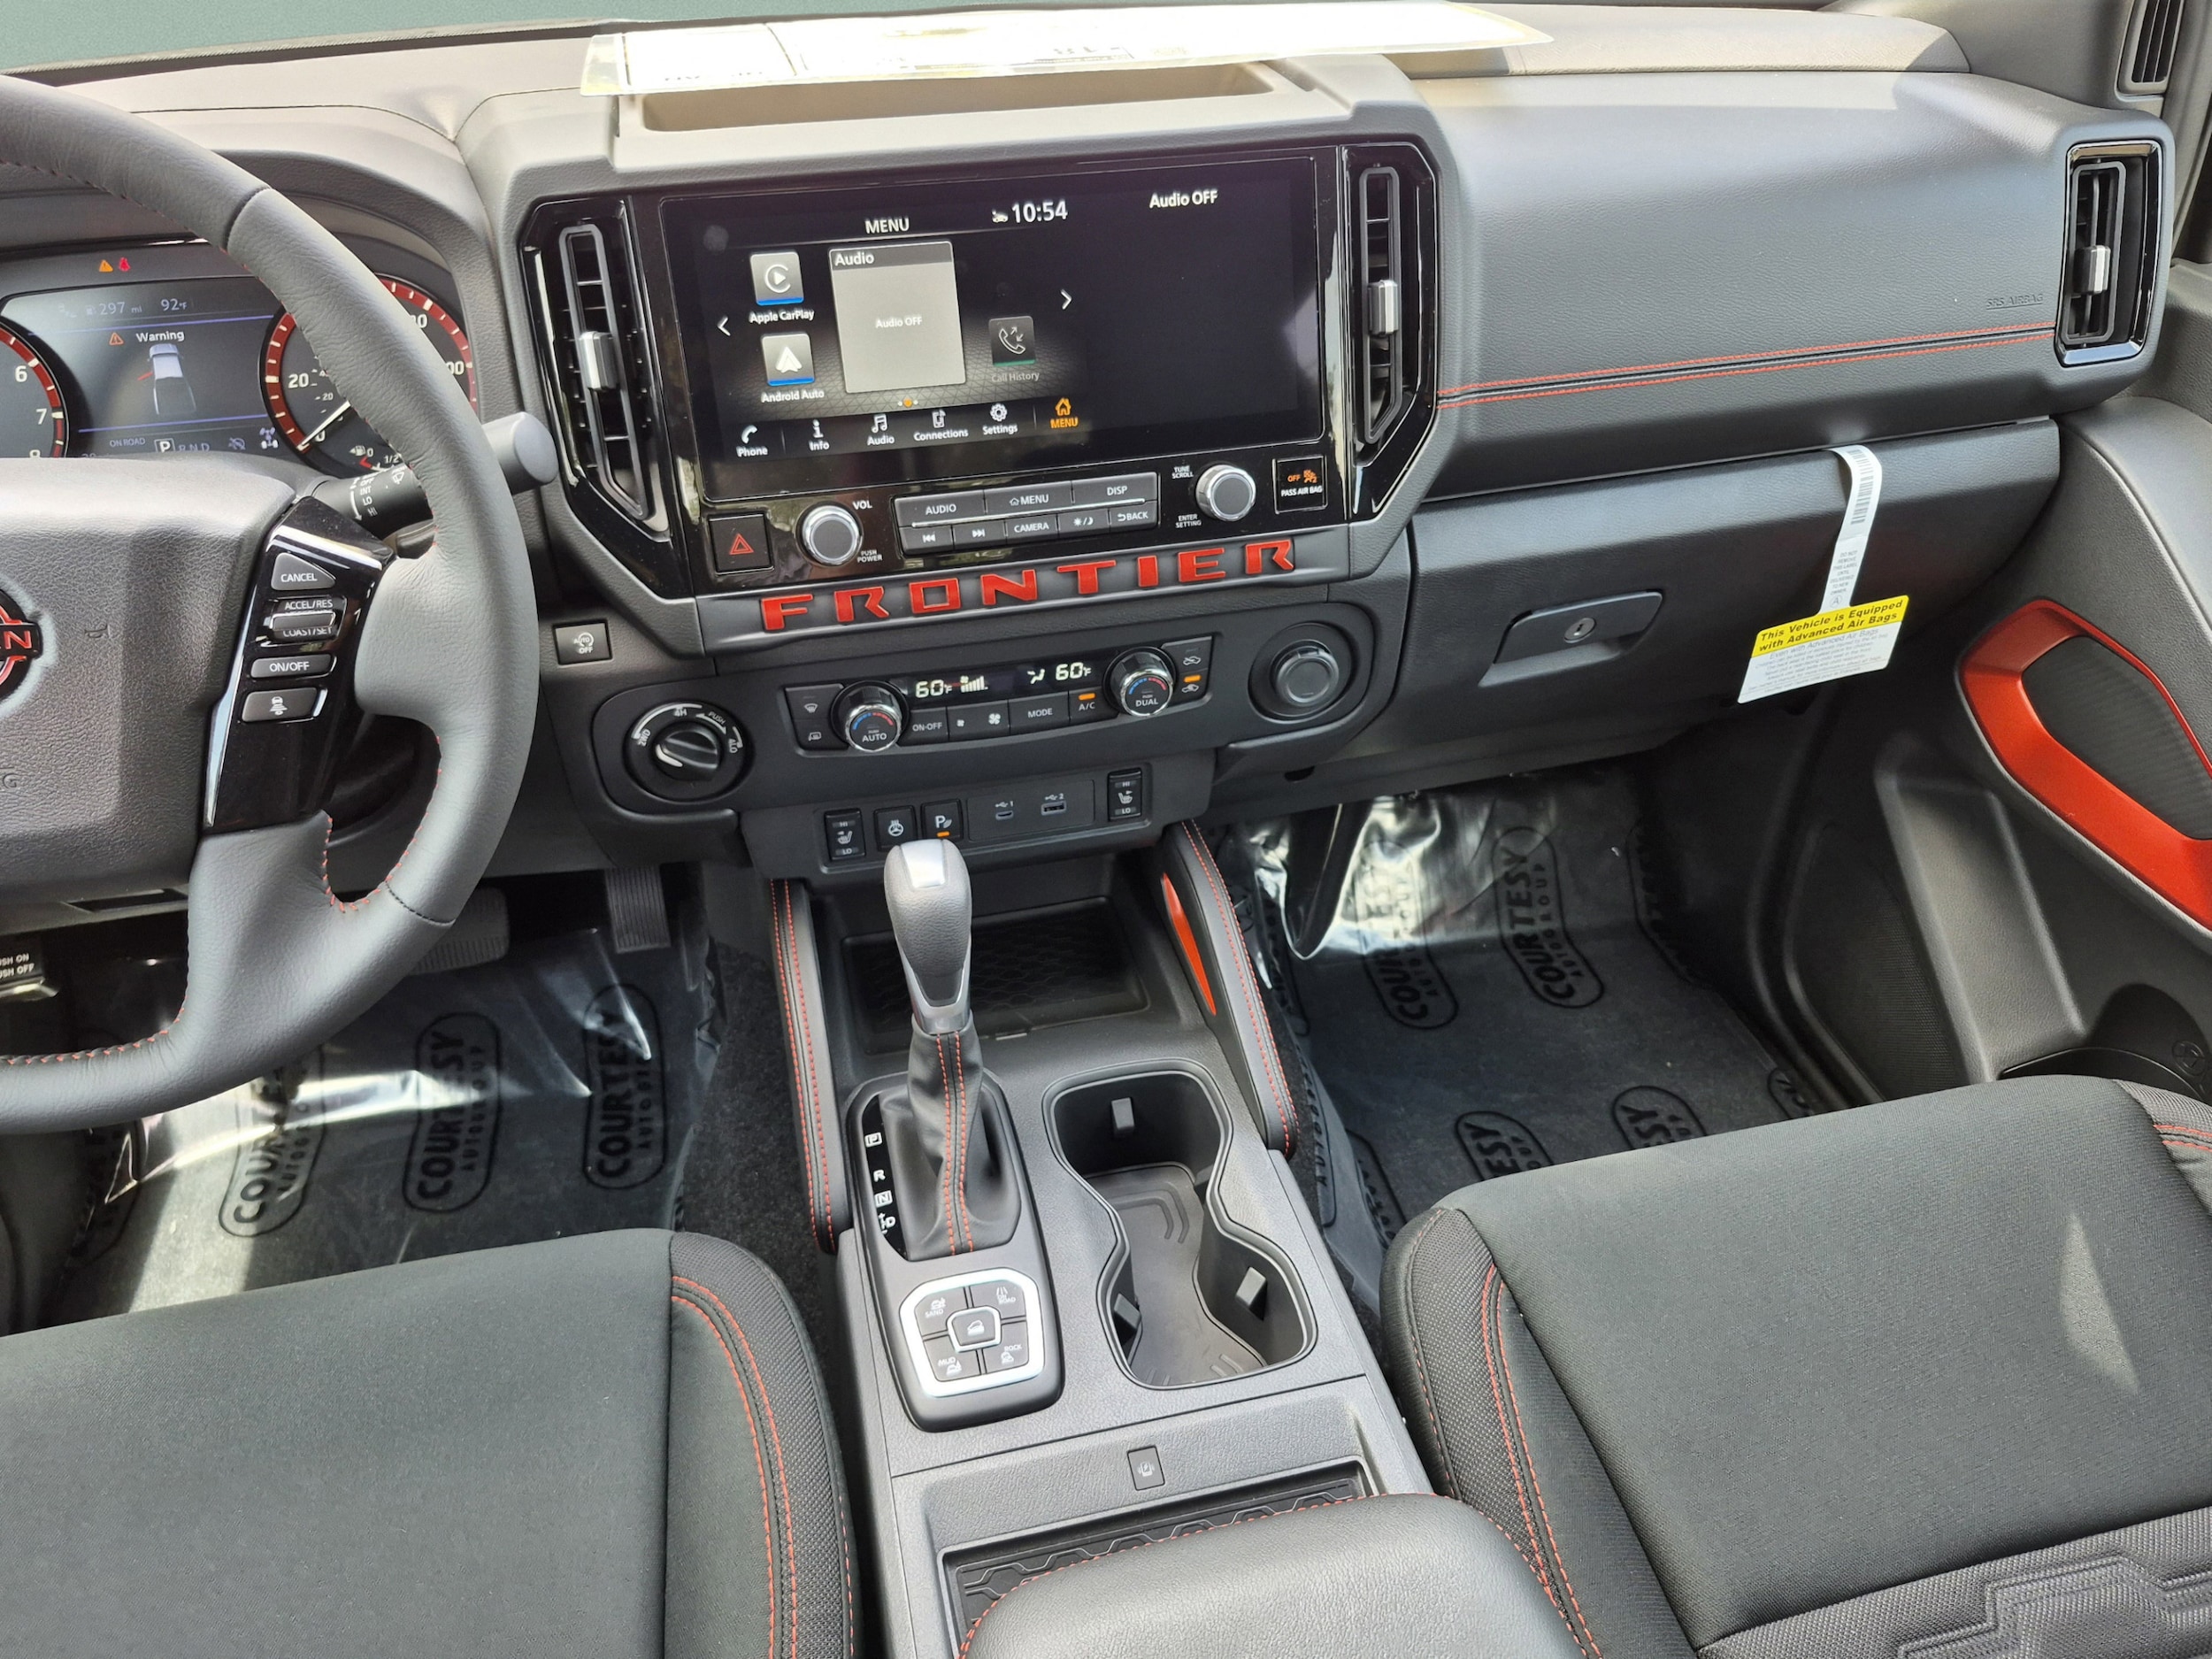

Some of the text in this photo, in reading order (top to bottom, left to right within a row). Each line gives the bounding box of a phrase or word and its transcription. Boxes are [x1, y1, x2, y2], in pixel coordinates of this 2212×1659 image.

[1149, 189, 1218, 209] Audio OFF
[1011, 200, 1068, 223] 10:54
[864, 218, 910, 234] MENU
[834, 252, 874, 266] Audio
[99, 302, 126, 316] 297
[749, 309, 815, 324] Apple CarPlay
[875, 316, 923, 329] Audio OFF
[136, 330, 185, 343] Warning
[15, 365, 27, 382] 6
[991, 371, 1040, 383] Call History
[288, 373, 310, 389] 20
[322, 392, 334, 401] 20
[761, 388, 825, 403] Android Auto
[35, 408, 47, 425] 7
[983, 423, 1018, 435] Settings
[1050, 417, 1078, 429] MENU
[867, 434, 895, 446] Audio
[914, 428, 968, 442] Connections
[123, 437, 146, 447] ROAD
[810, 440, 830, 451] Info
[736, 444, 768, 457] Phone
[1171, 470, 1194, 480] SCROLL
[1173, 465, 1191, 474] TUNE
[1287, 473, 1301, 482] OFF
[360, 486, 372, 495] INT
[1107, 486, 1128, 496] DISP
[1280, 485, 1323, 497] PASS AIR BAG
[363, 496, 373, 506] LO
[852, 500, 872, 511] VOL
[1020, 494, 1049, 505] MENU
[367, 507, 378, 517] HI
[925, 503, 956, 516] AUDIO
[1126, 511, 1148, 521] BACK
[1178, 514, 1198, 523] ENTER
[1014, 522, 1049, 534] CAMERA
[1175, 518, 1202, 529] SETTING
[856, 554, 883, 564] POWER
[861, 549, 878, 557] PUSH
[280, 572, 318, 582] CANCEL
[761, 538, 1294, 631] FRONTIER
[284, 599, 334, 611] ACCEL/RES
[1761, 600, 1903, 641] This Vehicle is Equipped
[282, 626, 333, 638] COAST/SET
[1759, 612, 1897, 652] with Advanced Air Bags
[269, 662, 310, 672] ON/OFF
[1079, 702, 1095, 712] A/C
[1135, 698, 1159, 708] DUAL
[708, 710, 726, 725] PUSH
[1027, 708, 1053, 718] MODE
[862, 733, 887, 743] AUTO
[1502, 846, 1576, 999] COURTESY
[1532, 863, 1584, 978] AUTOGROUP
[16, 953, 29, 964] ON
[17, 963, 35, 974] OFF
[873, 1170, 886, 1182] R
[925, 1309, 944, 1318] SAND
[938, 1356, 956, 1366] MUD
